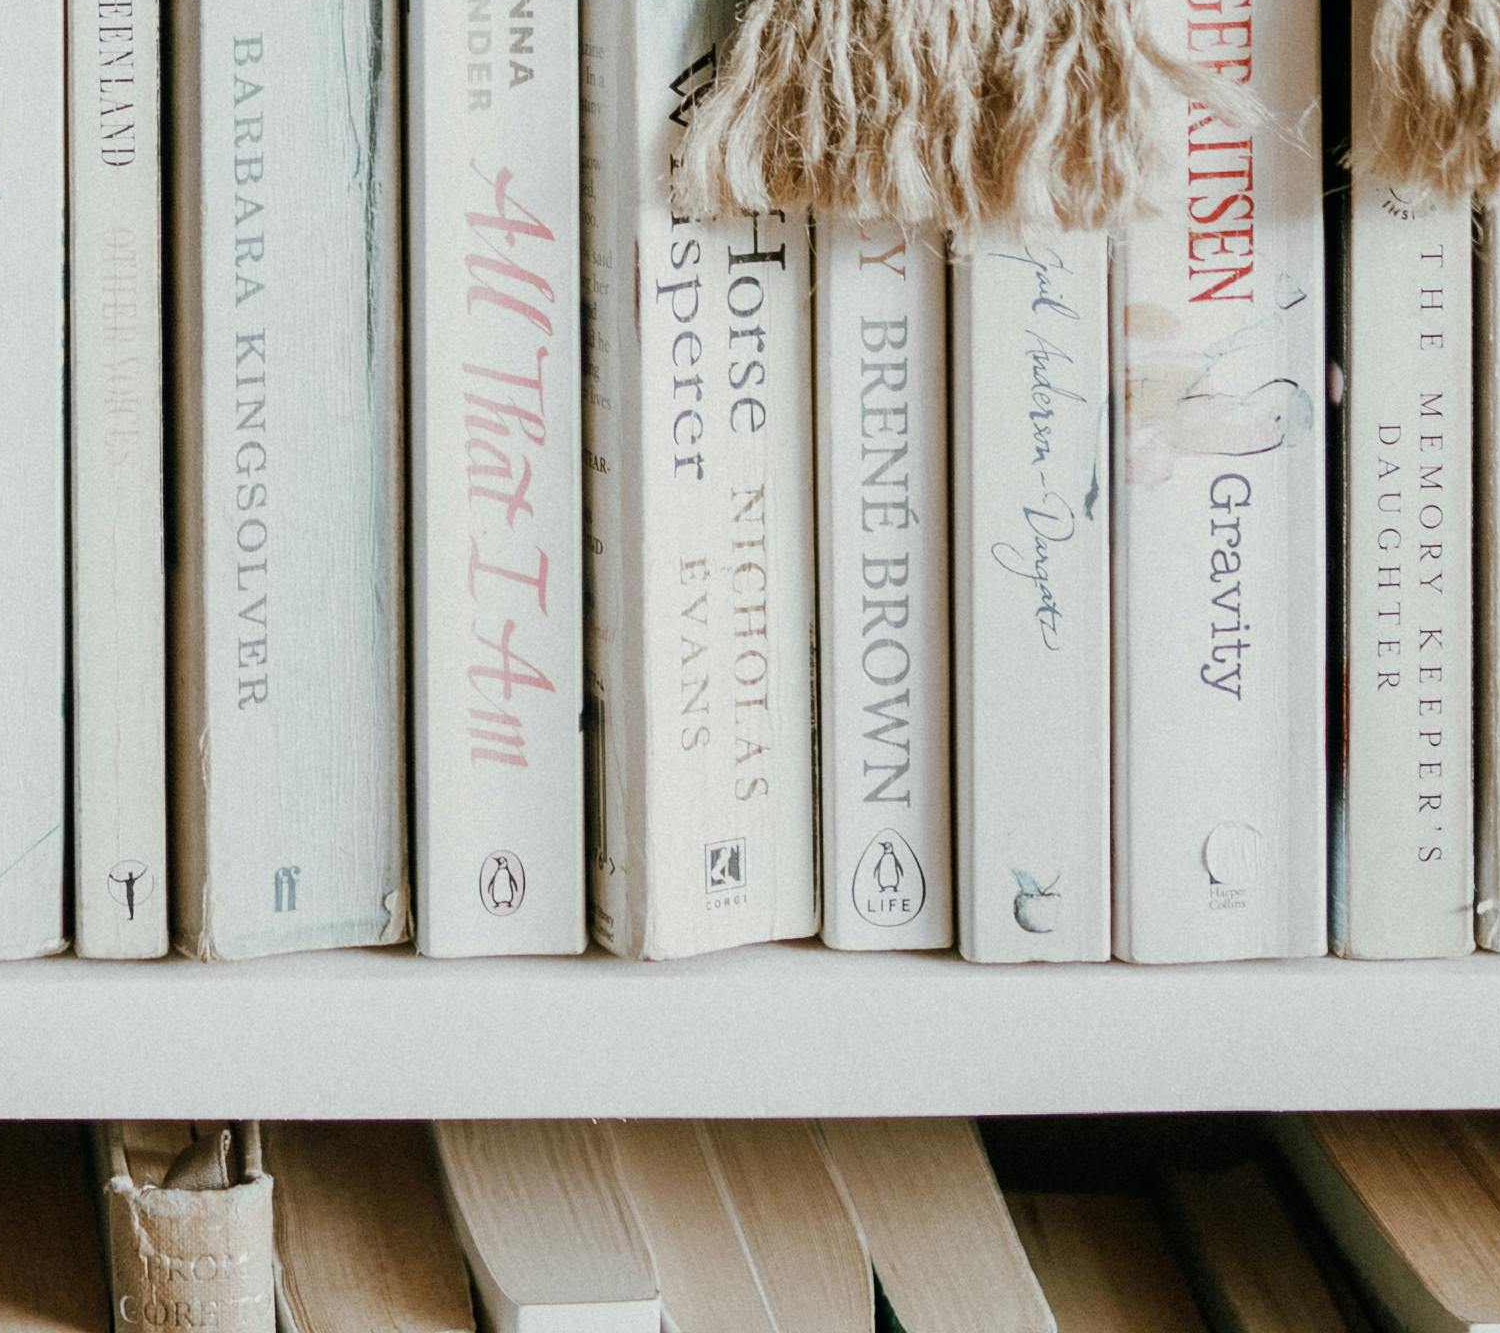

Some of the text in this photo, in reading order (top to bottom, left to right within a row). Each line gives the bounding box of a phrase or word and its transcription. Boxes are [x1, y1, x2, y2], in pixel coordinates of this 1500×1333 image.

[858, 313, 921, 809] BRENÉ BROWN
[1201, 471, 1253, 703] Gravity
[1376, 424, 1402, 693] DAUGHTER
[1418, 243, 1445, 864] THE MEMORY KEEPER'S
